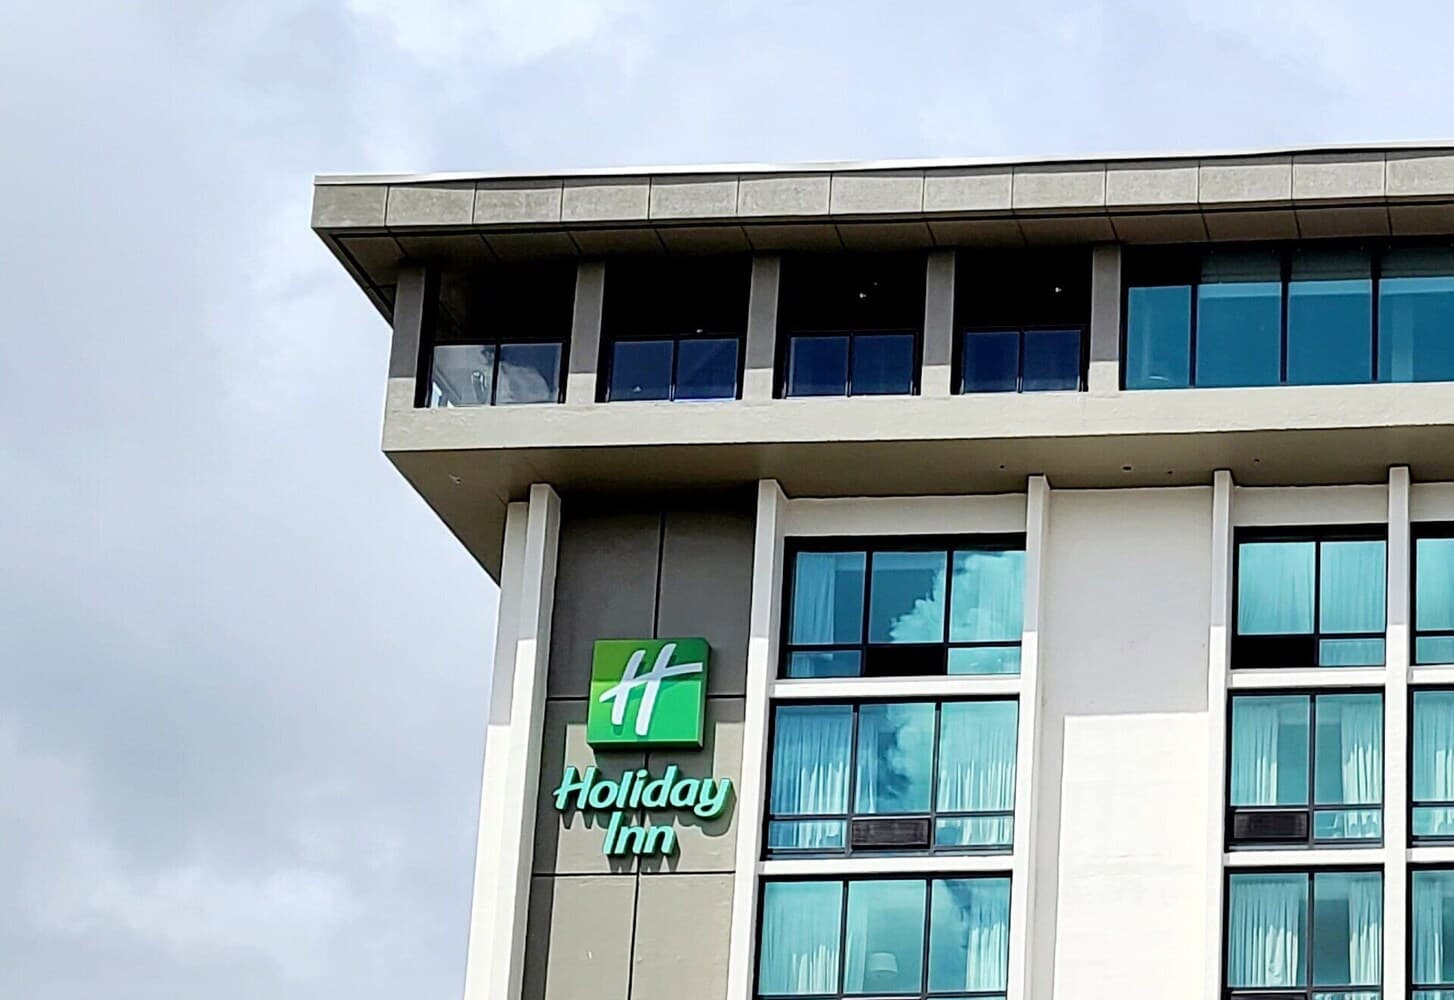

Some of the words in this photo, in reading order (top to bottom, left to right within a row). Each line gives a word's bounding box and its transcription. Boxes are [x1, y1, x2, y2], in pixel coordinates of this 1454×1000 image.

[599, 643, 704, 736] H
[553, 765, 731, 818] Holiday
[603, 811, 677, 855] Inn
